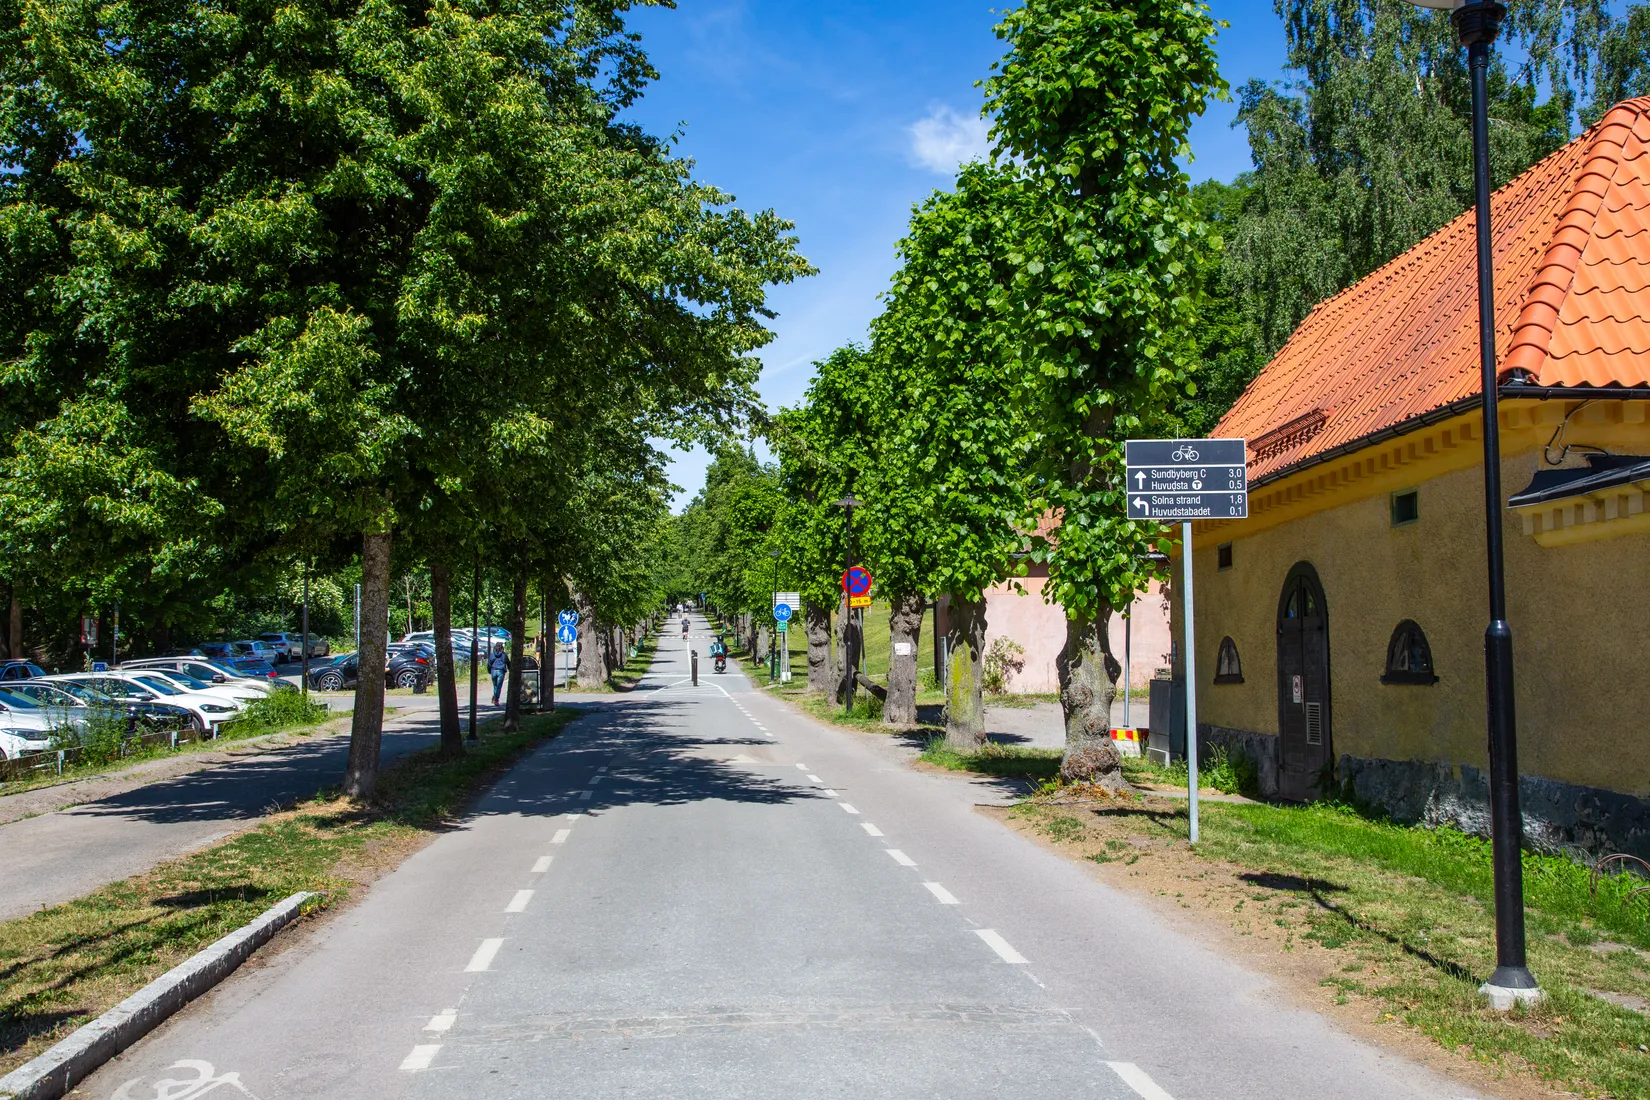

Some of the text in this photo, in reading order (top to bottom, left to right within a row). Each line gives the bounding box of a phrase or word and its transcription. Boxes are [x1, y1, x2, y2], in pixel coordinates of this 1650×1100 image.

[1152, 469, 1206, 479] Sundbyberg C
[1228, 468, 1242, 478] 3,0
[1152, 481, 1188, 490] Huvudsta
[1229, 480, 1242, 490] 0,5
[1152, 496, 1200, 504] Solna strand
[1230, 495, 1242, 505] 1,8
[1152, 507, 1210, 516] Huvudstabadet
[1230, 506, 1242, 516] 0,1
